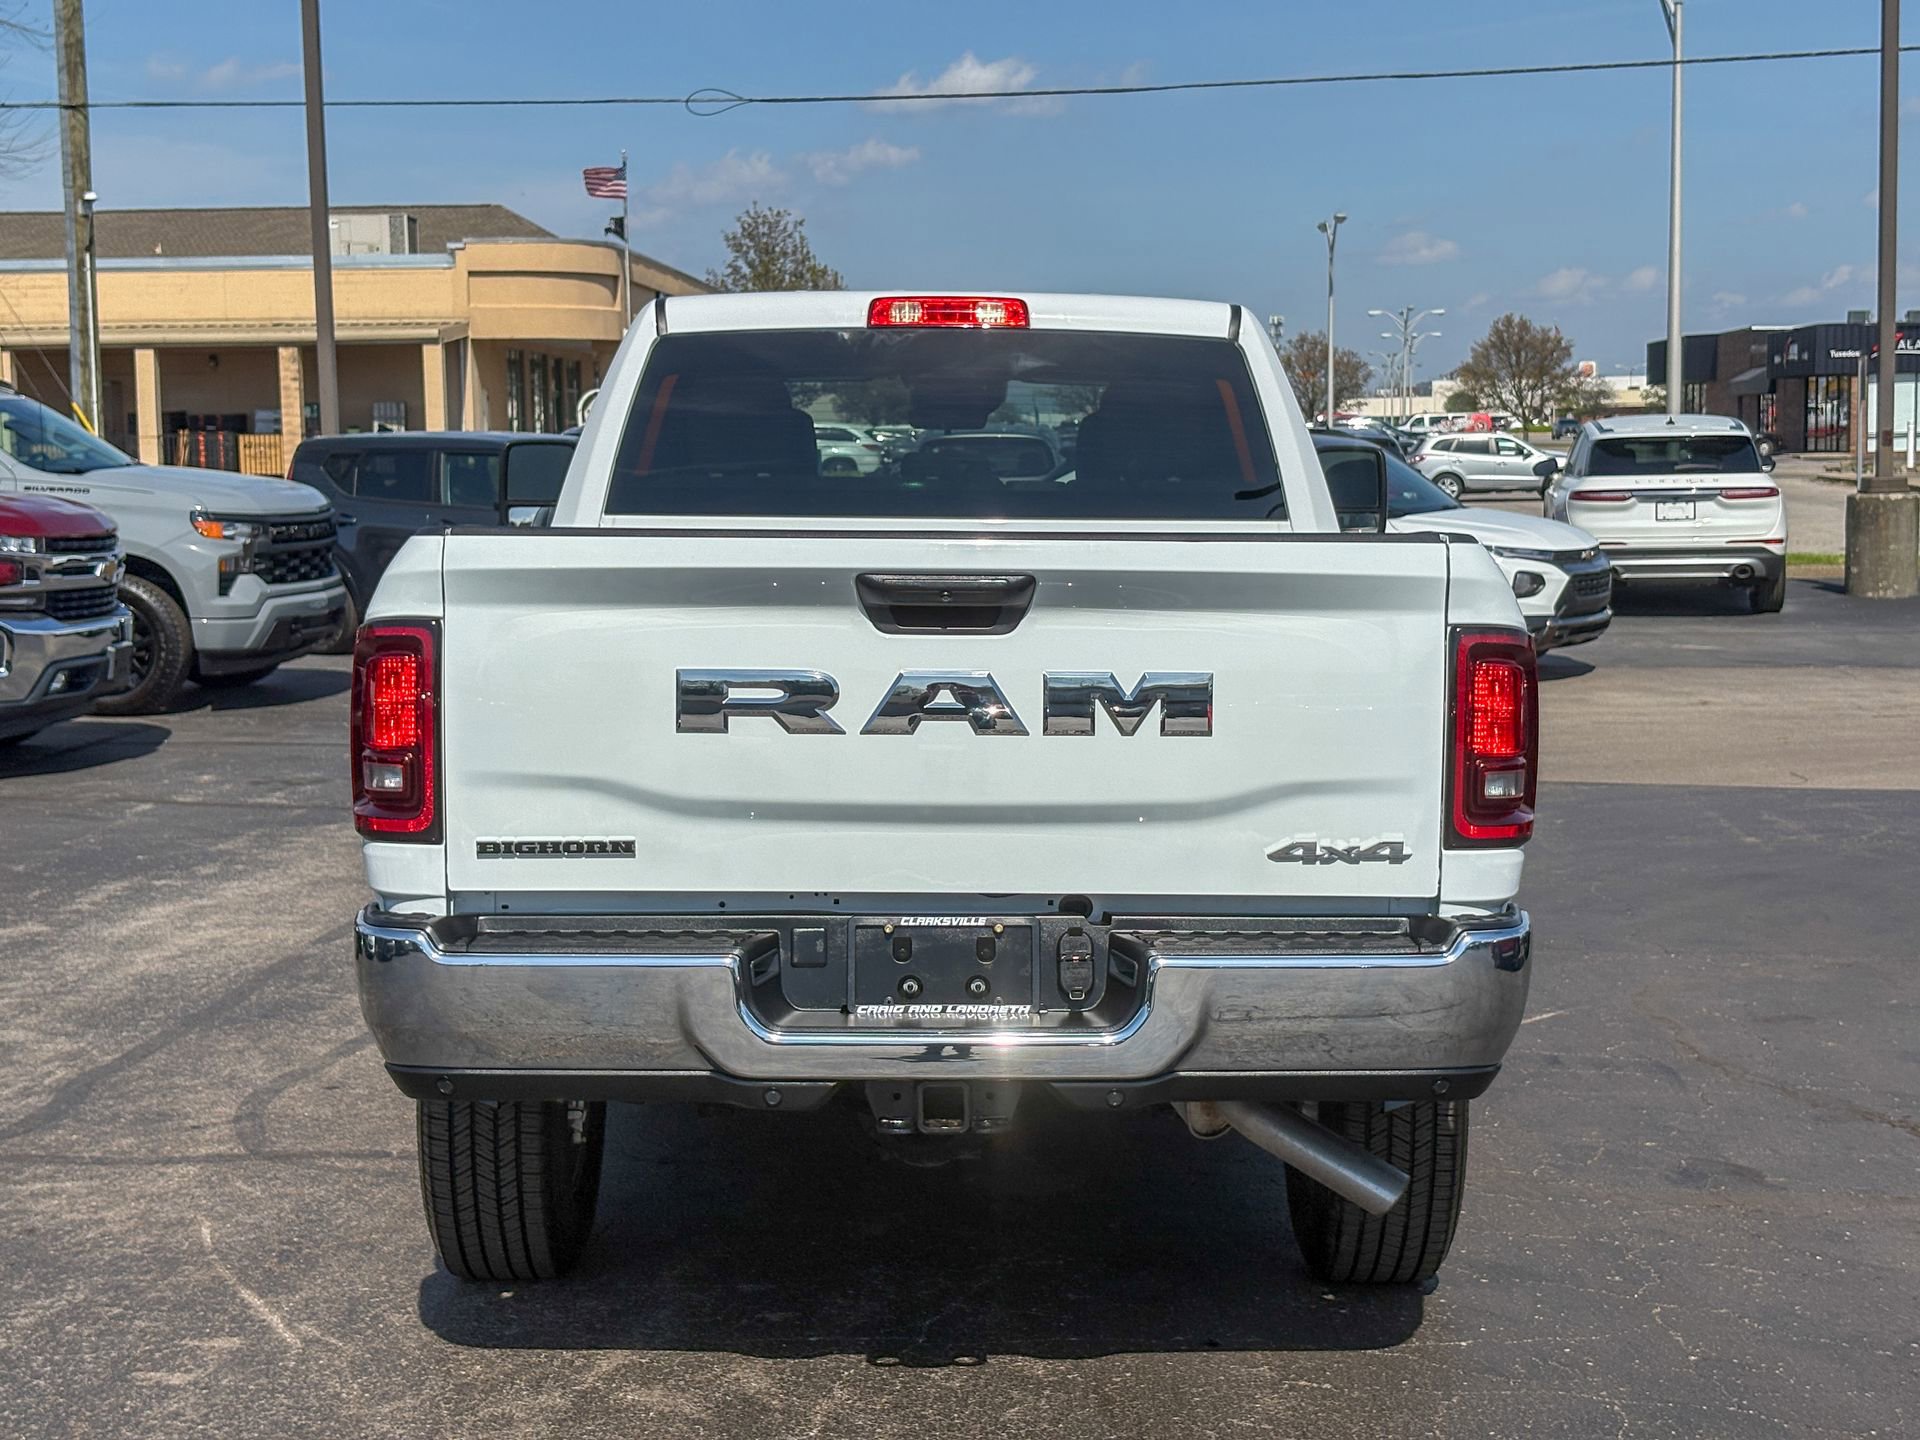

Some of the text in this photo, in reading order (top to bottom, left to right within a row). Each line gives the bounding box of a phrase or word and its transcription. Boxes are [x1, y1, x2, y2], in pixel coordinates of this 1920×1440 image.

[675, 667, 1214, 737] RAM
[476, 839, 637, 859] BIGHORN
[1266, 841, 1413, 866] 4x4
[900, 916, 987, 926] CLARKSVILLE
[857, 1004, 1032, 1014] CRAIG AND LANDRETH
